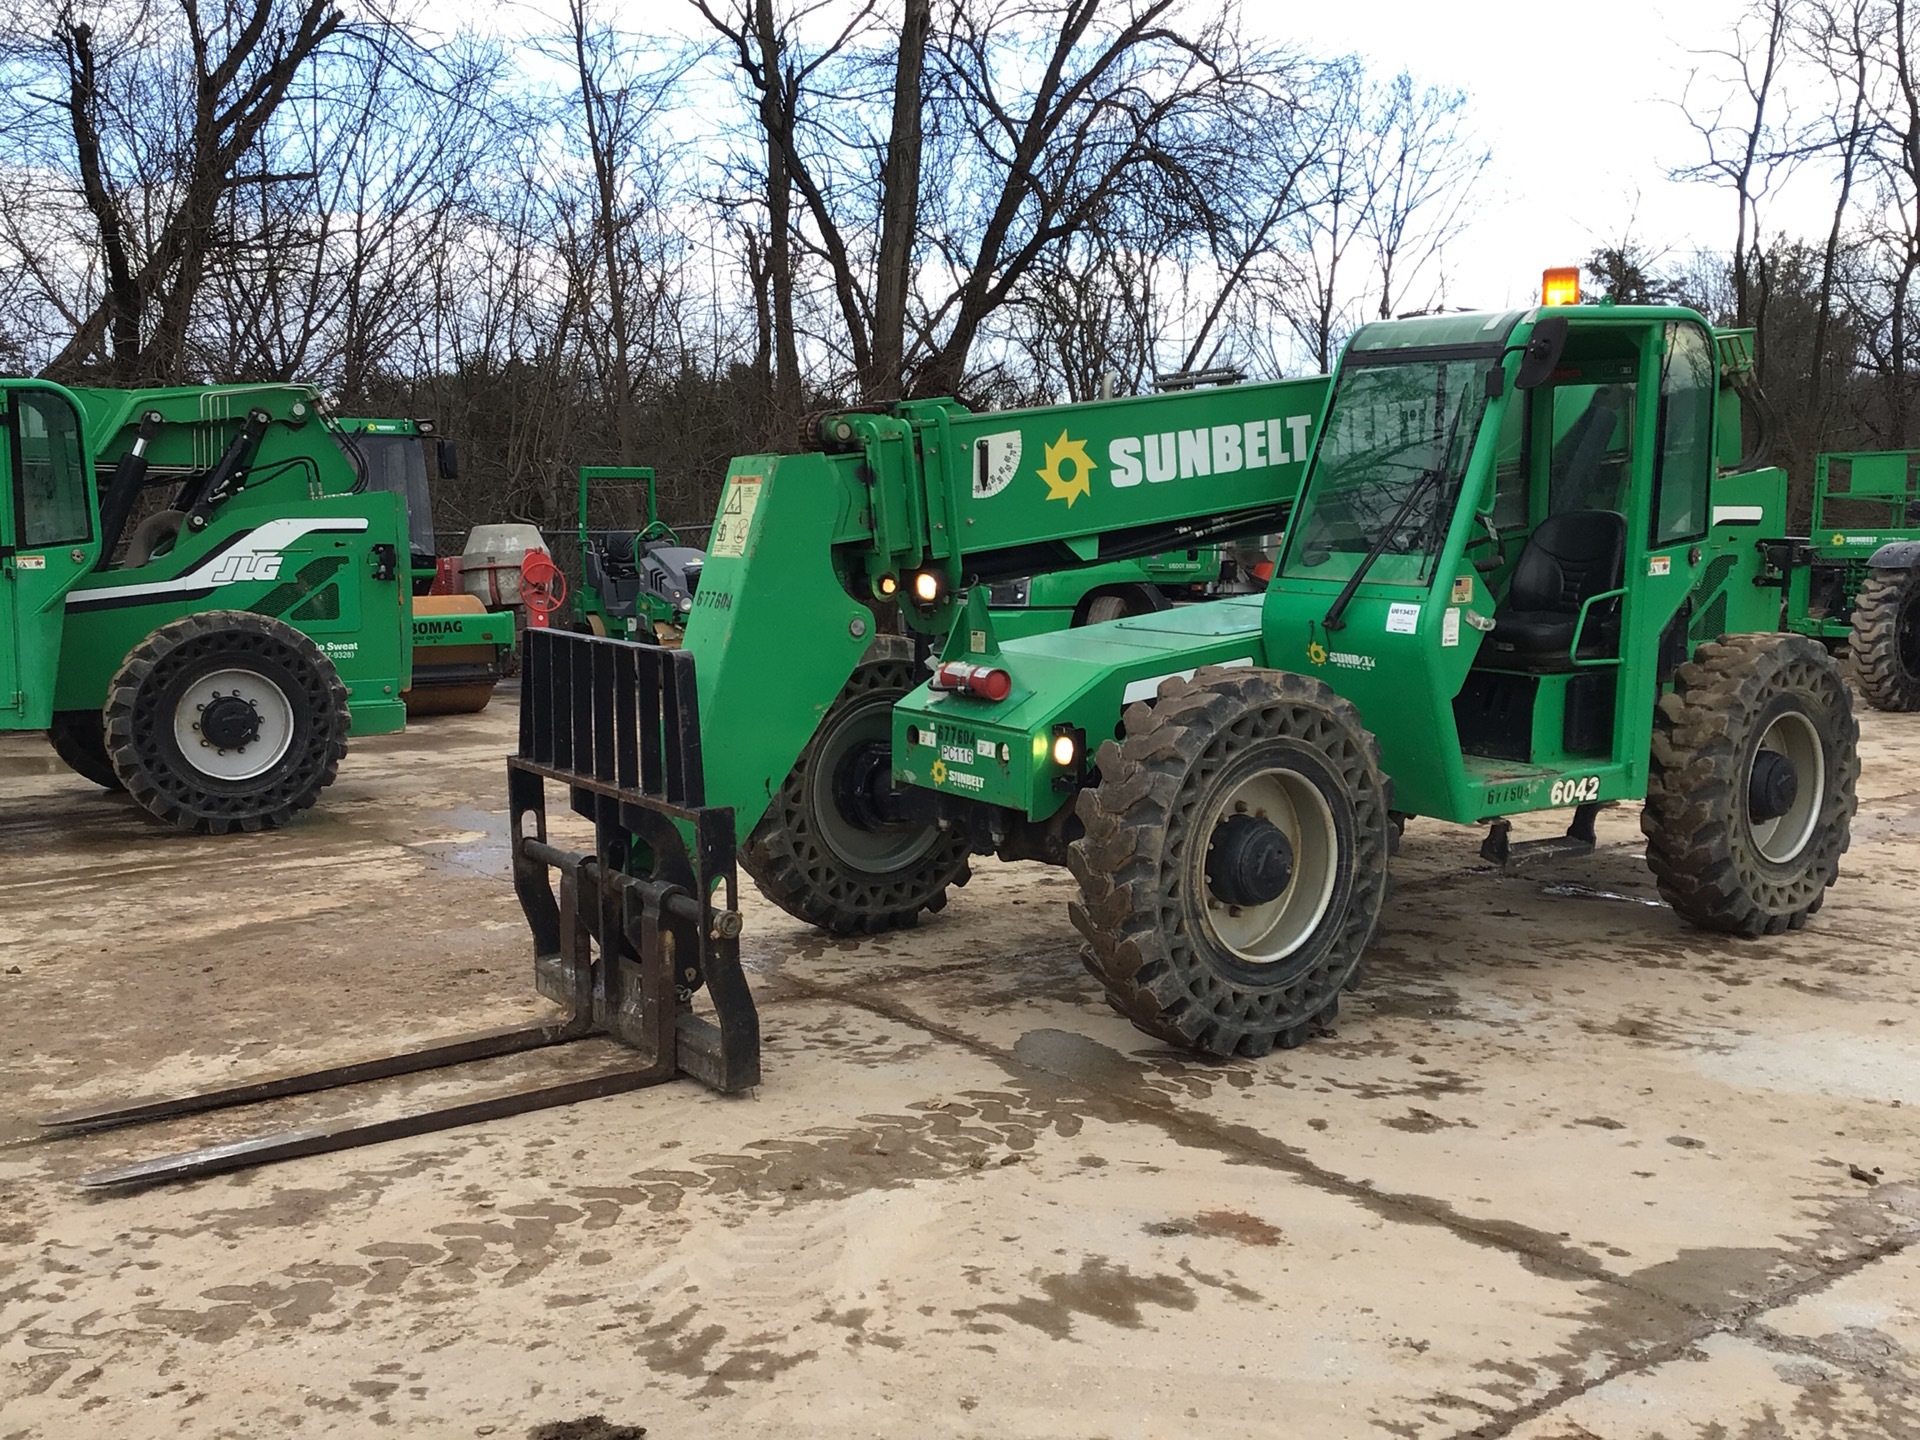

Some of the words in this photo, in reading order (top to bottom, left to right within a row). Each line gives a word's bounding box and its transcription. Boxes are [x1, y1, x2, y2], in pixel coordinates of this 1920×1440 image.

[1108, 414, 1312, 488] SUNBELT
[211, 556, 284, 582] JLG
[696, 590, 734, 611] 677604
[1391, 608, 1418, 616] U613437
[326, 641, 359, 651] Sweat
[937, 725, 976, 747] 677604
[943, 745, 973, 764] PC116
[948, 770, 985, 789] SUNBELT
[1550, 776, 1600, 806] 6042
